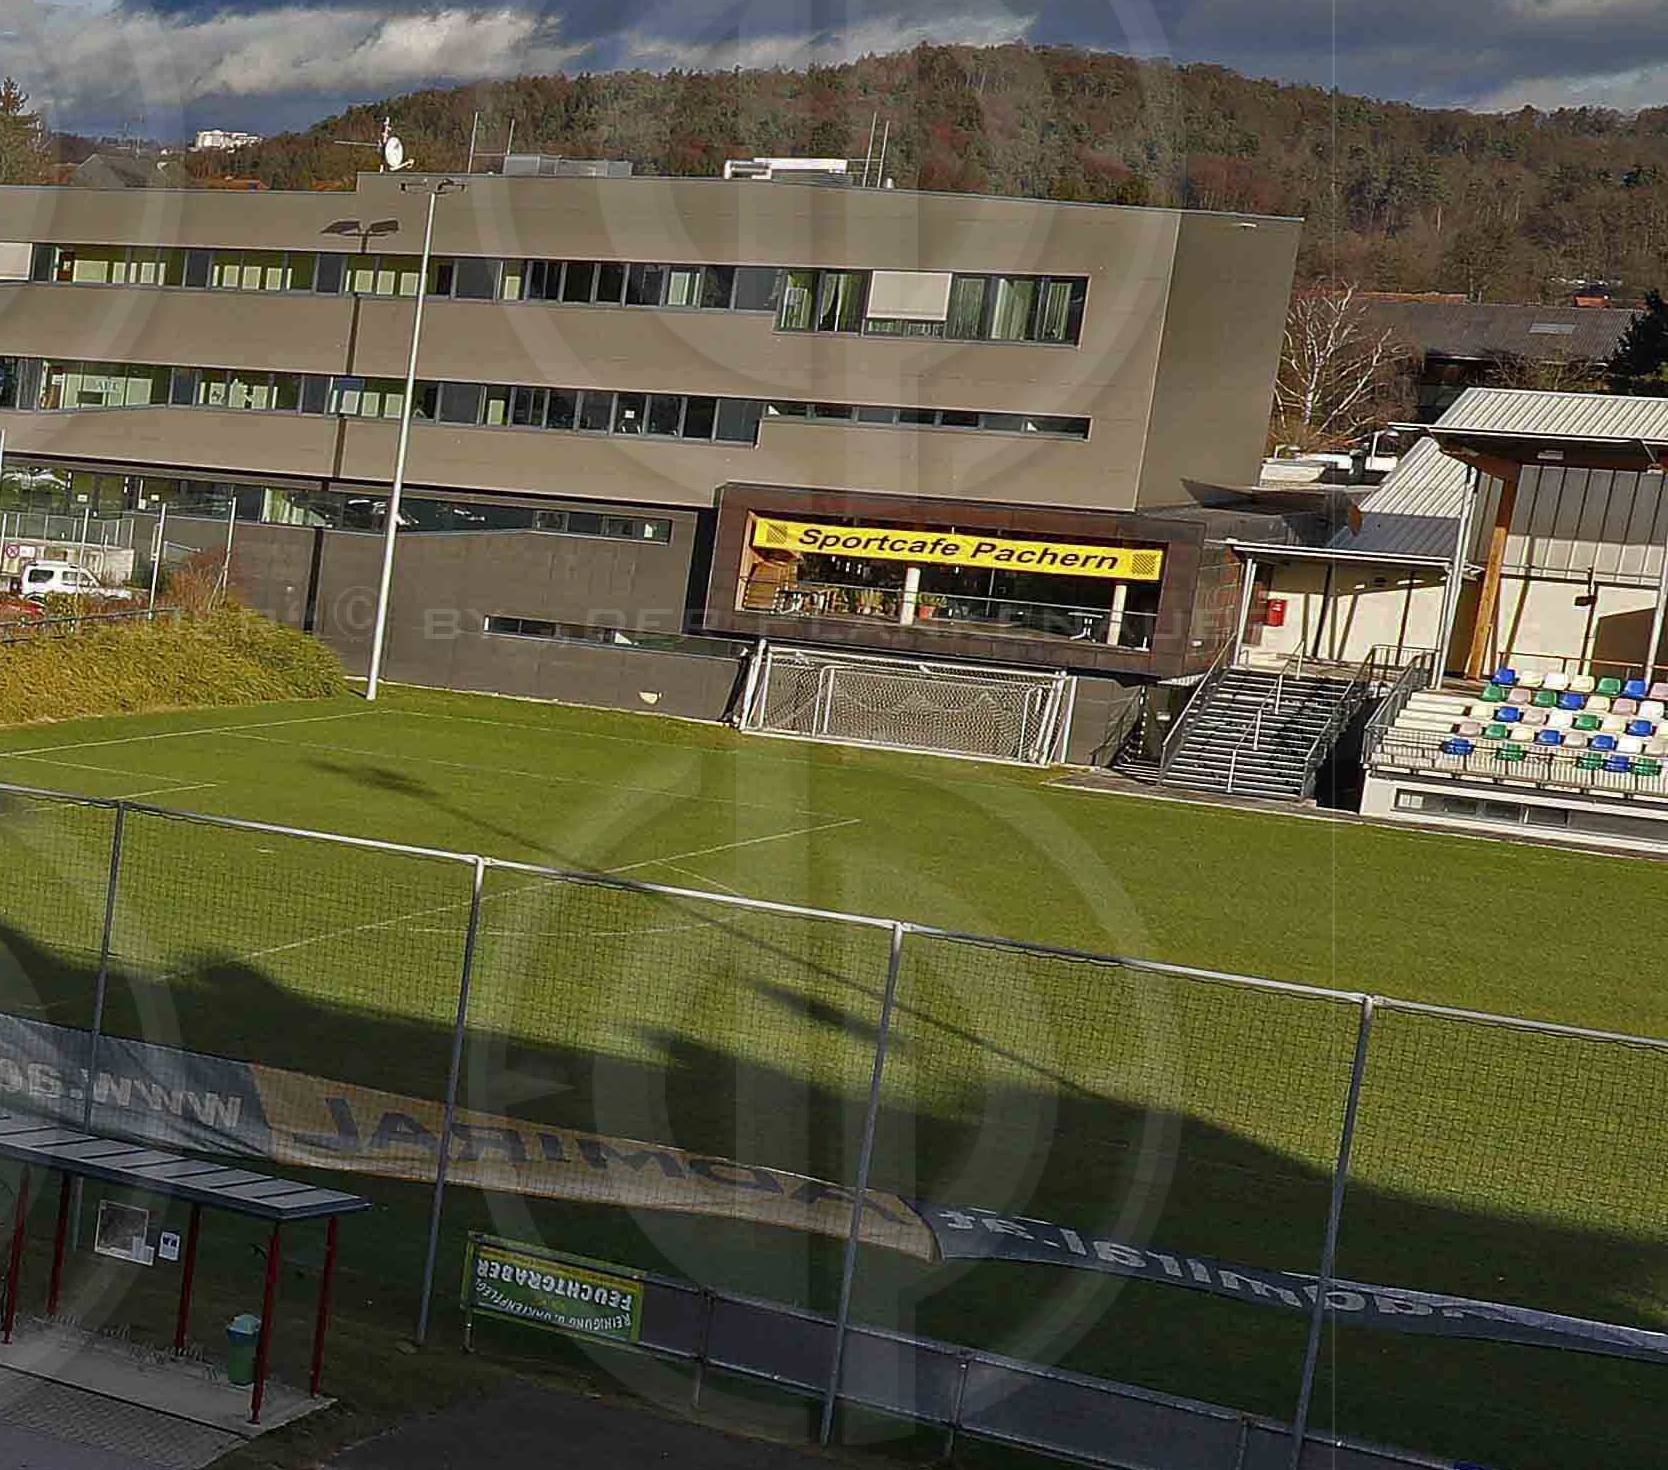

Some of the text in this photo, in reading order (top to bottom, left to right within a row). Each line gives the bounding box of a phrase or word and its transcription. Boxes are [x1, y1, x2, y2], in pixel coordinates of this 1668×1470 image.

[799, 528, 1118, 570] Sportcafe Pachern
[477, 1259, 633, 1311] FEUCHTGRABER
[569, 1313, 631, 1331] REINIGUNG
